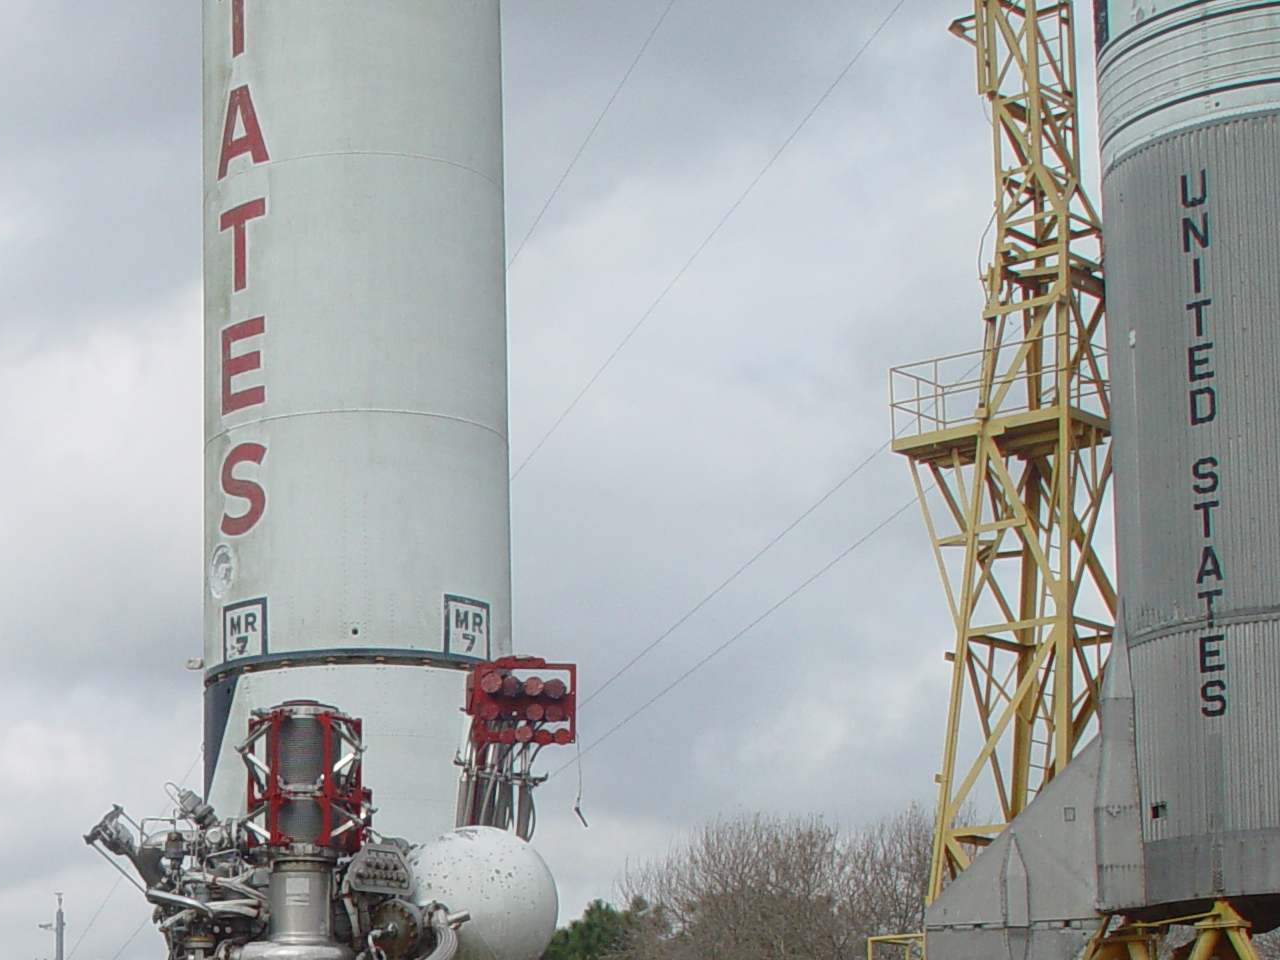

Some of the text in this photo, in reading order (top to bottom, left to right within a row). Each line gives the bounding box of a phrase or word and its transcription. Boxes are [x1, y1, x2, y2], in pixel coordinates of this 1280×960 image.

[1180, 168, 1227, 717] UNITED STATES
[230, 611, 257, 636] MR
[455, 608, 483, 634] MR
[236, 635, 249, 655] 7
[461, 632, 476, 652] 7
